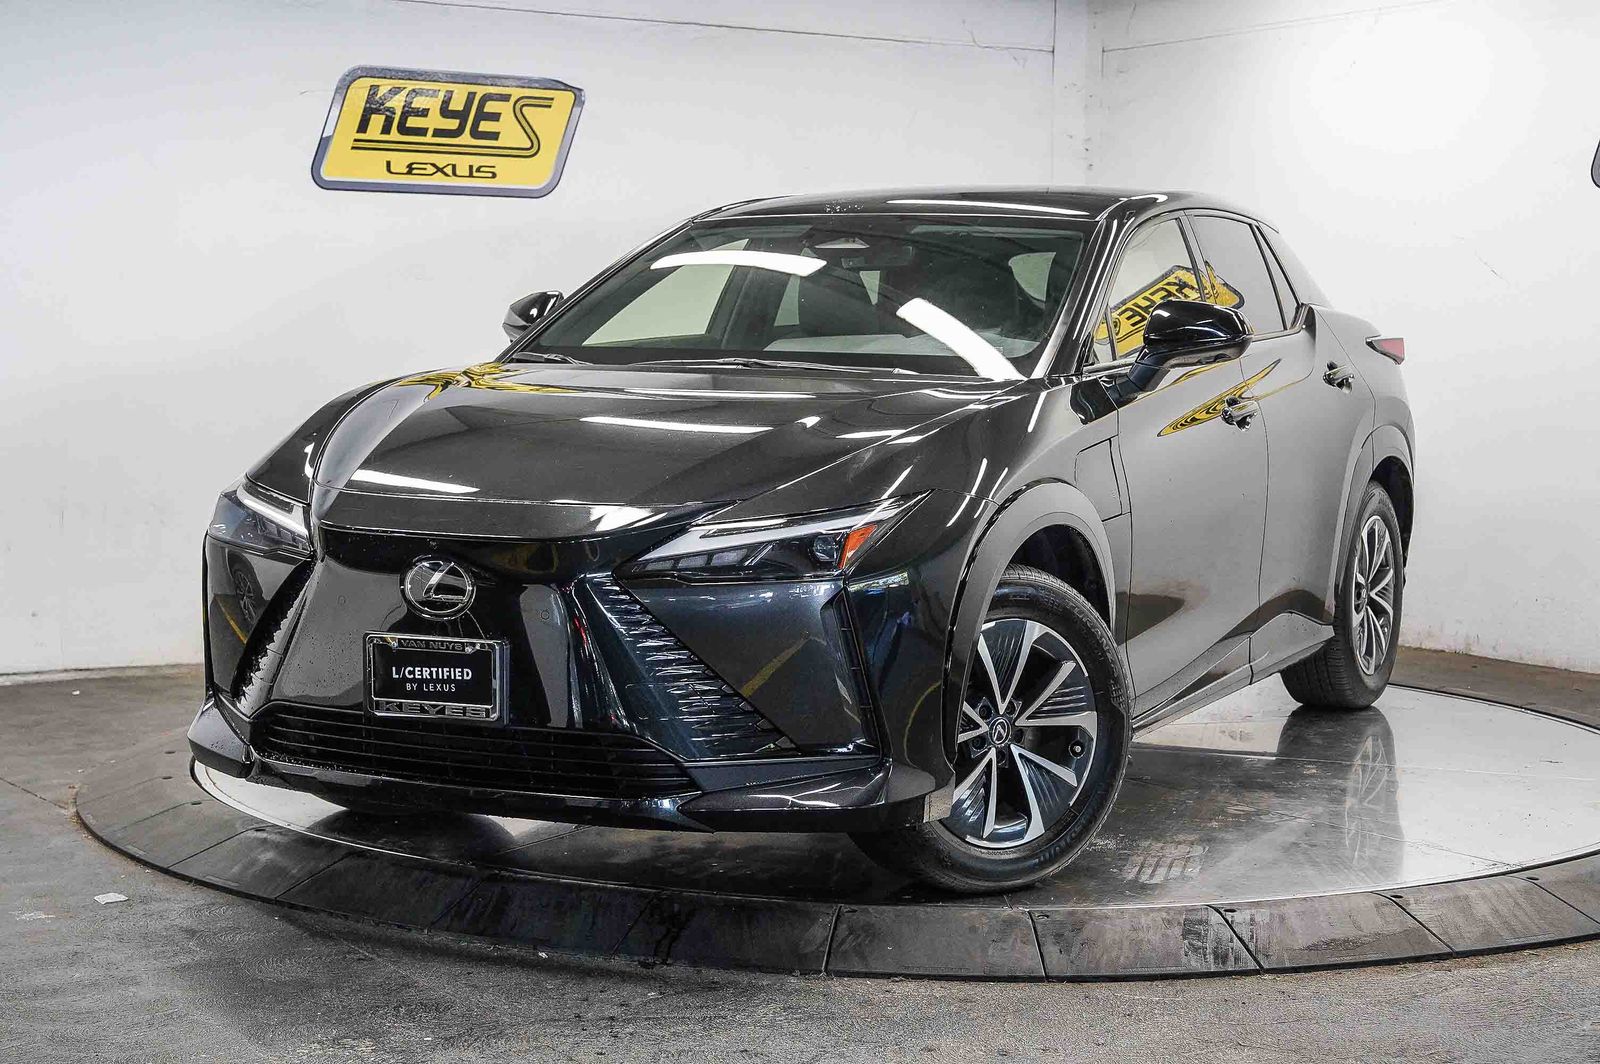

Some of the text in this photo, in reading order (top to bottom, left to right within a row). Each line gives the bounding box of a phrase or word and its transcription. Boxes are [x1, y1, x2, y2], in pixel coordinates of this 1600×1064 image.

[351, 84, 554, 158] KEYES
[385, 160, 497, 179] LEXUS
[401, 639, 463, 650] VAN NUYS
[392, 666, 472, 680] L/CERTIFIED
[406, 682, 456, 692] BY LEXUS
[378, 701, 486, 718] KEYES
